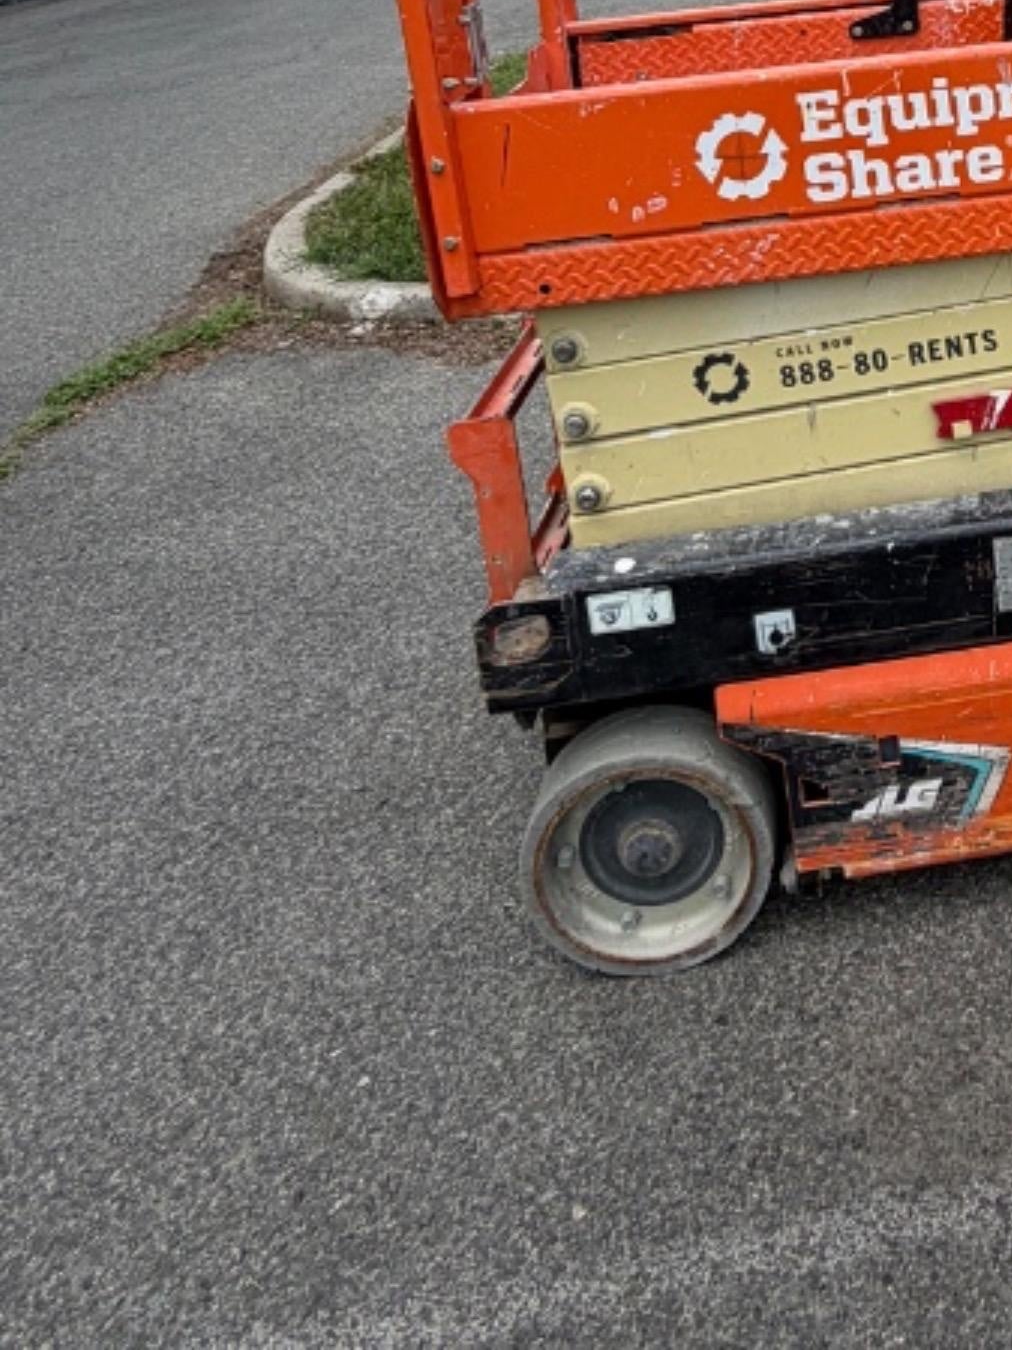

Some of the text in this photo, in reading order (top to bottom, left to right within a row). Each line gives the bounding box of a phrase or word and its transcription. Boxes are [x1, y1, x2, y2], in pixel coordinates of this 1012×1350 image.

[803, 143, 1004, 203] Share
[775, 335, 854, 358] CALL NOW
[779, 329, 998, 388] 888-80-RENTS
[851, 777, 943, 823] JLG
